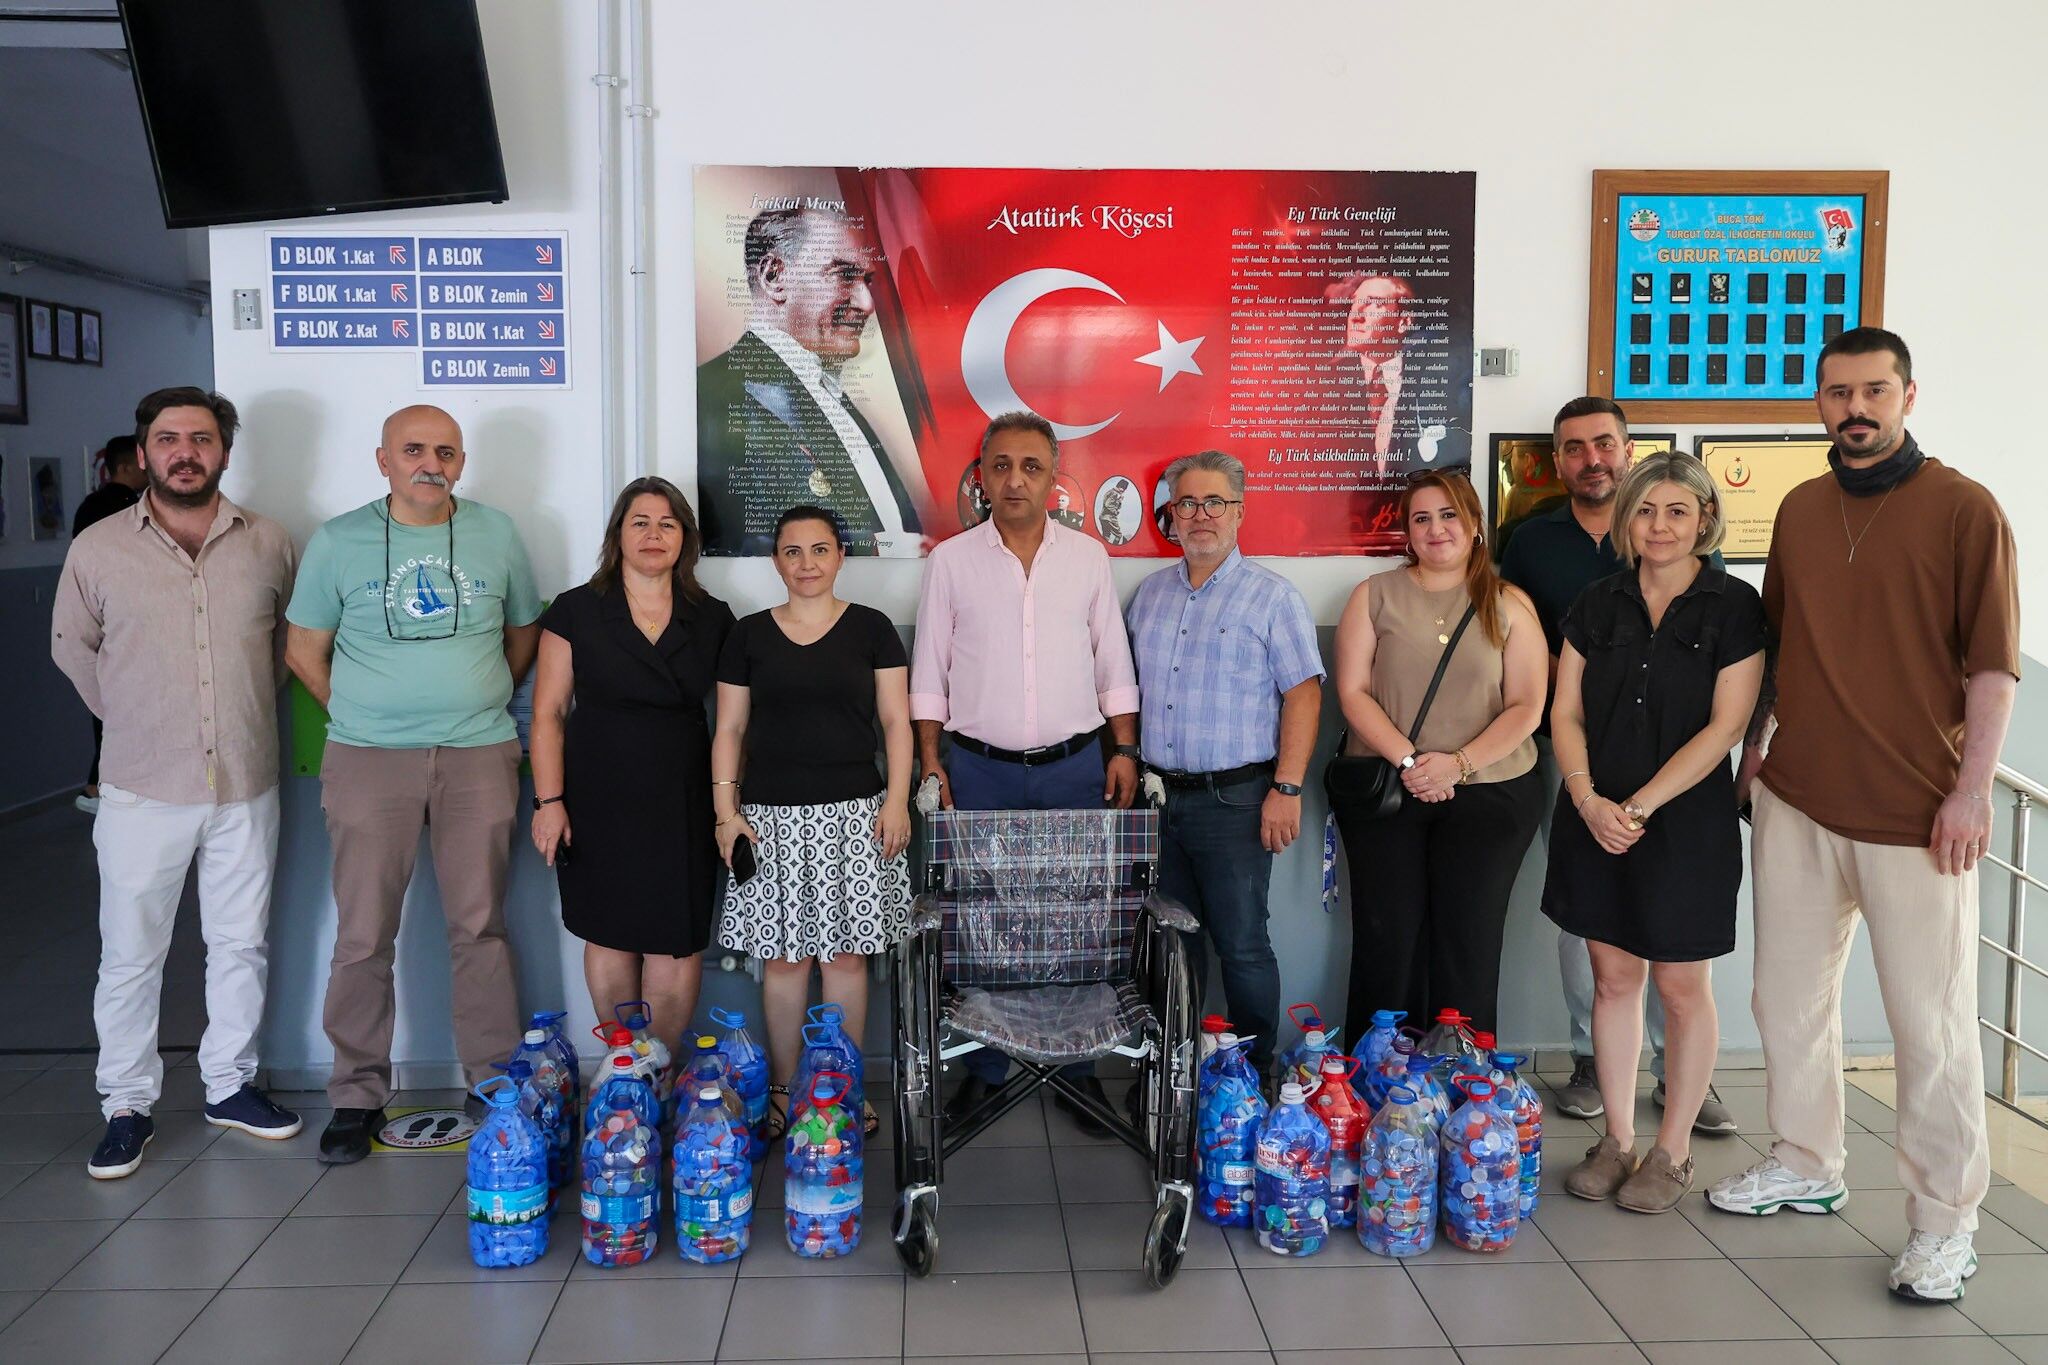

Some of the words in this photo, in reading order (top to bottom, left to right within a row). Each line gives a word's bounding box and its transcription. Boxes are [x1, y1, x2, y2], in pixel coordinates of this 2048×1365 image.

[750, 194, 799, 209] İstiklal
[804, 197, 846, 212] Marşı
[987, 206, 1084, 234] Atatürk
[1092, 206, 1173, 238] Köşesi
[1288, 207, 1305, 223] Ey
[1310, 207, 1340, 220] Türk
[1344, 207, 1396, 223] Gençliği
[1718, 216, 1741, 224] BUCA
[1744, 213, 1765, 224] TOKİ
[1666, 230, 1701, 239] TURGUT
[1704, 228, 1726, 239] ÖZAL
[1784, 230, 1815, 239] OKULU
[280, 247, 290, 264] D
[296, 247, 336, 264] BLOK
[343, 250, 374, 264] 1.Kat
[427, 248, 438, 265] A
[443, 248, 483, 265] BLOK
[1658, 248, 1720, 263] GURUR
[1725, 248, 1822, 263] TABLOMUZ
[281, 285, 290, 302] F
[298, 285, 337, 302] BLOK
[344, 288, 376, 302] 1.Kat
[429, 286, 439, 303] B
[445, 286, 484, 303] BLOK
[491, 288, 528, 303] Zemin
[283, 321, 292, 338] F
[299, 321, 339, 338] BLOK
[345, 324, 377, 338] 2.Kat
[430, 322, 440, 340] B
[447, 322, 486, 340] BLOK
[493, 325, 524, 340] 1.Kat
[432, 360, 441, 377] C
[448, 360, 487, 377] BLOK
[494, 363, 530, 377] Zemin
[1268, 449, 1282, 464] Ey
[1286, 449, 1310, 462] Türk
[1313, 449, 1369, 462] istikbalinin
[1407, 449, 1411, 462] !
[386, 558, 417, 608] SAILING
[426, 555, 471, 606] CALENDAR
